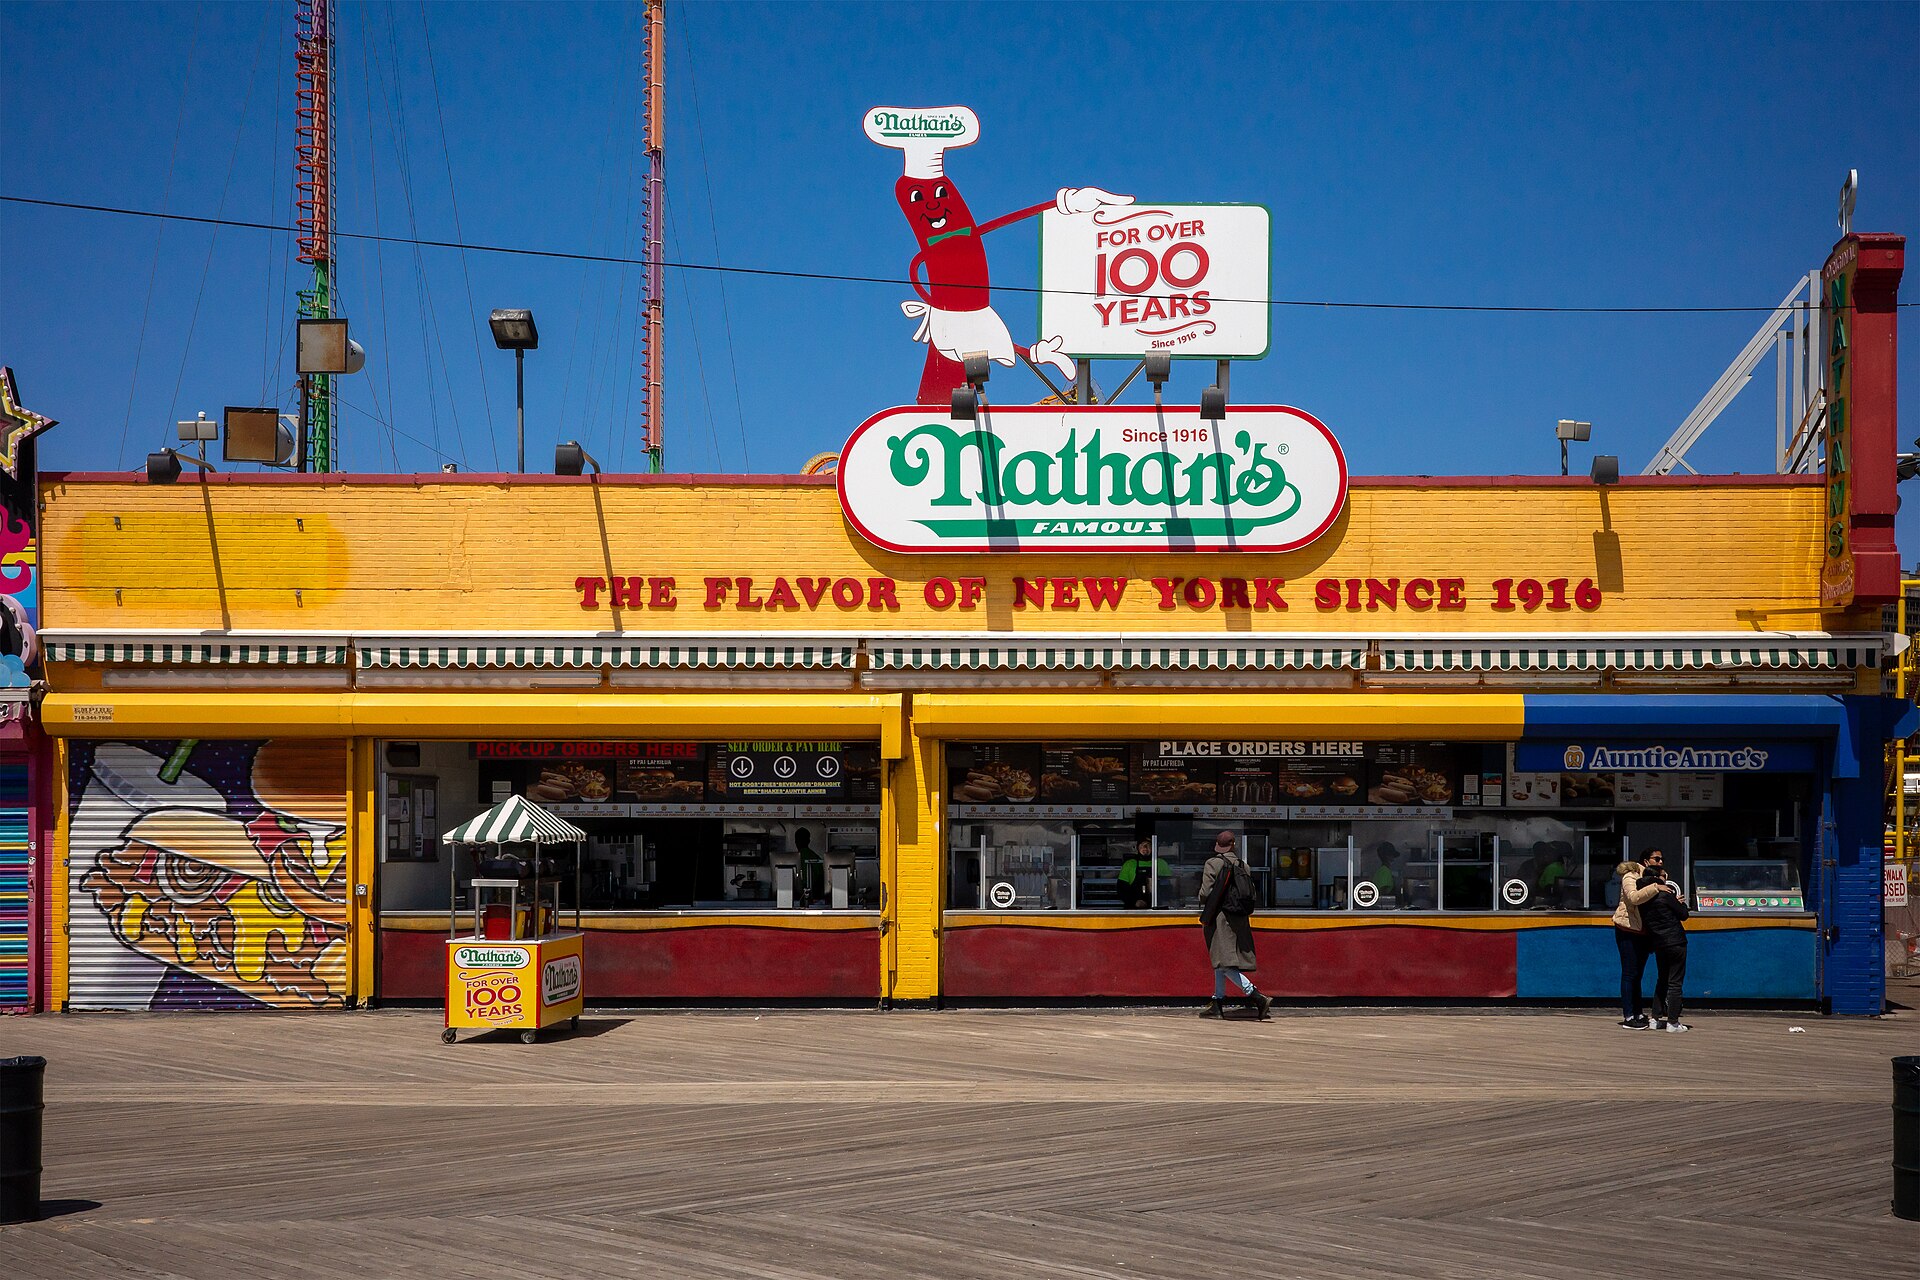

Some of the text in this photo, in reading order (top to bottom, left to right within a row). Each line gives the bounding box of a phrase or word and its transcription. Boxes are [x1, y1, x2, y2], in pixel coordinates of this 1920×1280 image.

[874, 112, 966, 132] Nathan's
[1096, 219, 1206, 249] FOR OVER
[1096, 241, 1211, 298] 100
[1094, 290, 1212, 326] YEARS
[1151, 331, 1197, 349] Since 1916
[1827, 273, 1848, 559] NATHANS
[1122, 428, 1208, 443] Since 1916
[887, 424, 1302, 510] Nathan's
[1031, 521, 1168, 535] FAMOUS
[576, 577, 1603, 610] THE FLAVOR OF NEW YORK SINCE 1916
[476, 742, 697, 757] PICK-UP ORDERS HERE
[728, 742, 842, 752] SELF ORDER & PAY HERE
[1159, 742, 1222, 755] PLACE
[1227, 742, 1306, 756] ORDERS
[1312, 742, 1364, 755] HERE
[460, 948, 525, 963] Nathan's
[466, 976, 519, 989] FOR OVER
[545, 961, 578, 992] Nathan's
[466, 985, 522, 1008] 100
[465, 1003, 523, 1019] YEARS
